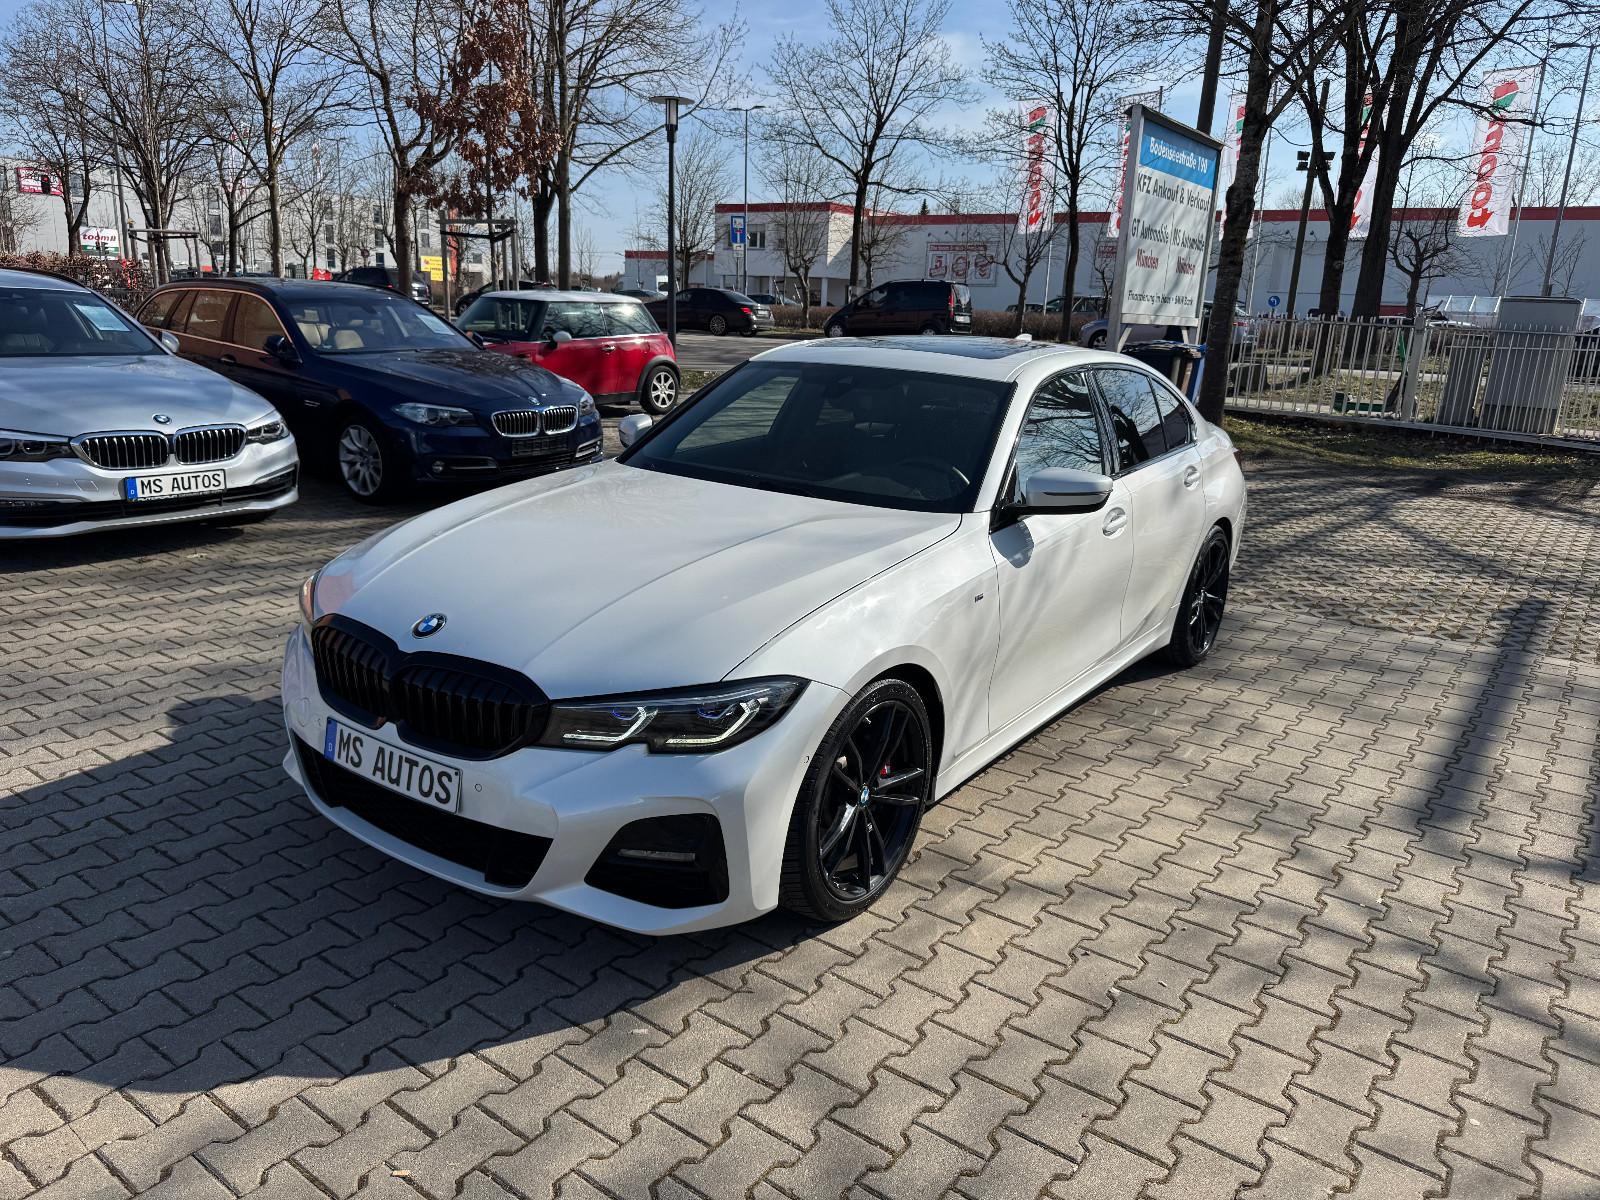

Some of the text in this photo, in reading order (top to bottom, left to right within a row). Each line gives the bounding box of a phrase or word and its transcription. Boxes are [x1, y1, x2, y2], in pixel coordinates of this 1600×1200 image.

[1150, 138, 1208, 173] Bodenseestraße 190
[1137, 174, 1211, 212] KFZ Ankauf & Verkauf
[83, 233, 110, 242] toom
[1131, 218, 1169, 243] GT Automobile
[1136, 248, 1159, 269] München
[140, 473, 222, 495] MS AUTOS
[337, 728, 453, 804] MS AUTOS
